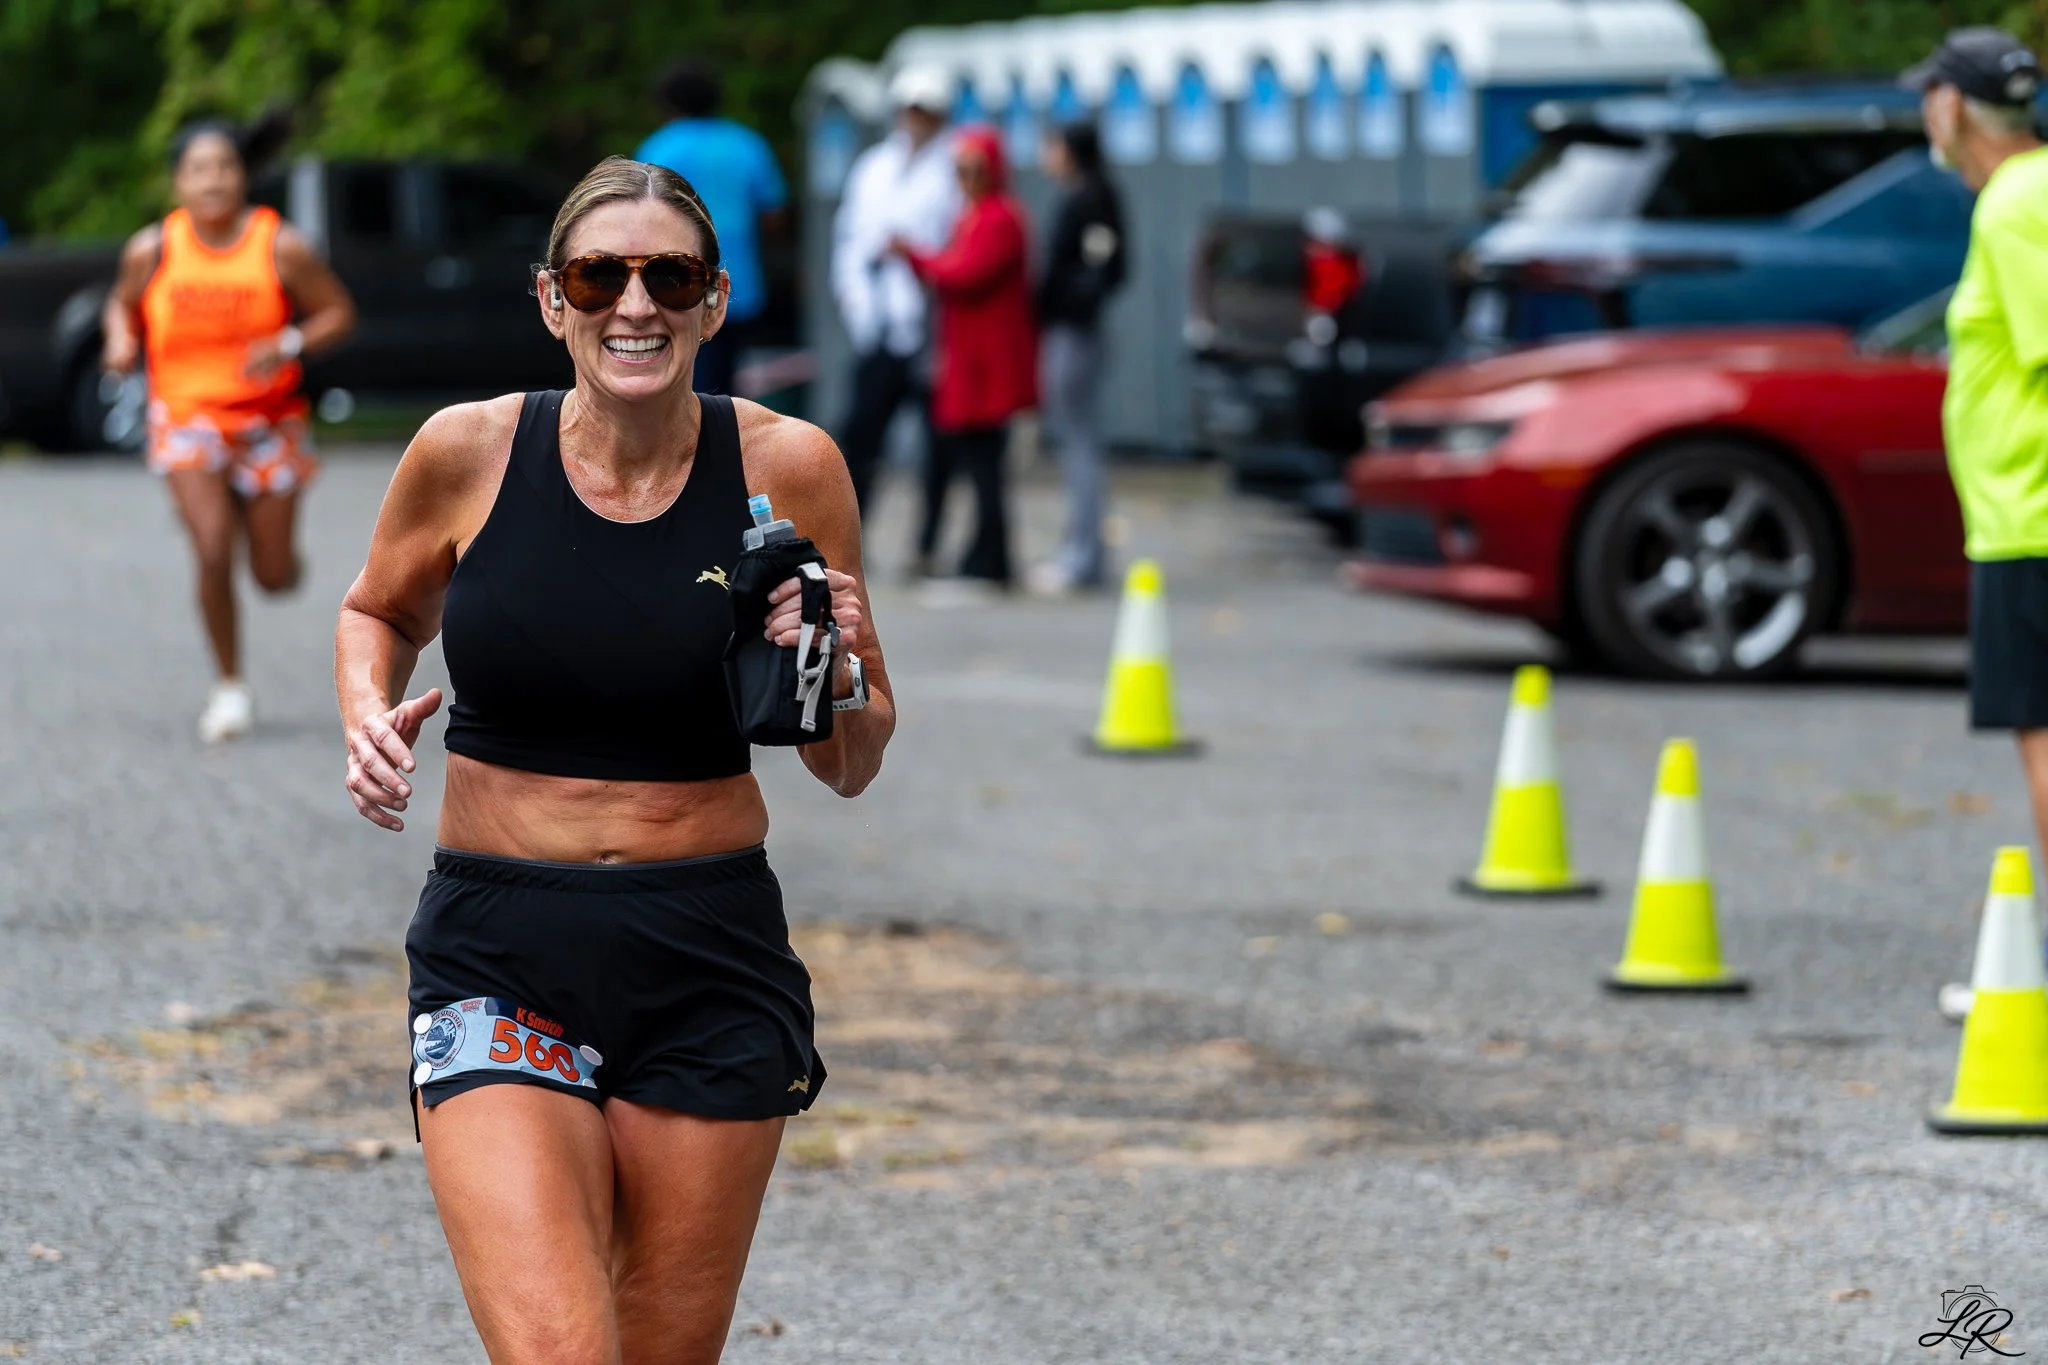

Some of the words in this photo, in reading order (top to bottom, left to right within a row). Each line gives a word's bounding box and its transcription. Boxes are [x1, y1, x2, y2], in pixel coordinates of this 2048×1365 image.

[516, 1007, 527, 1024] K
[526, 1011, 565, 1038] Smith
[489, 1018, 580, 1083] 560
